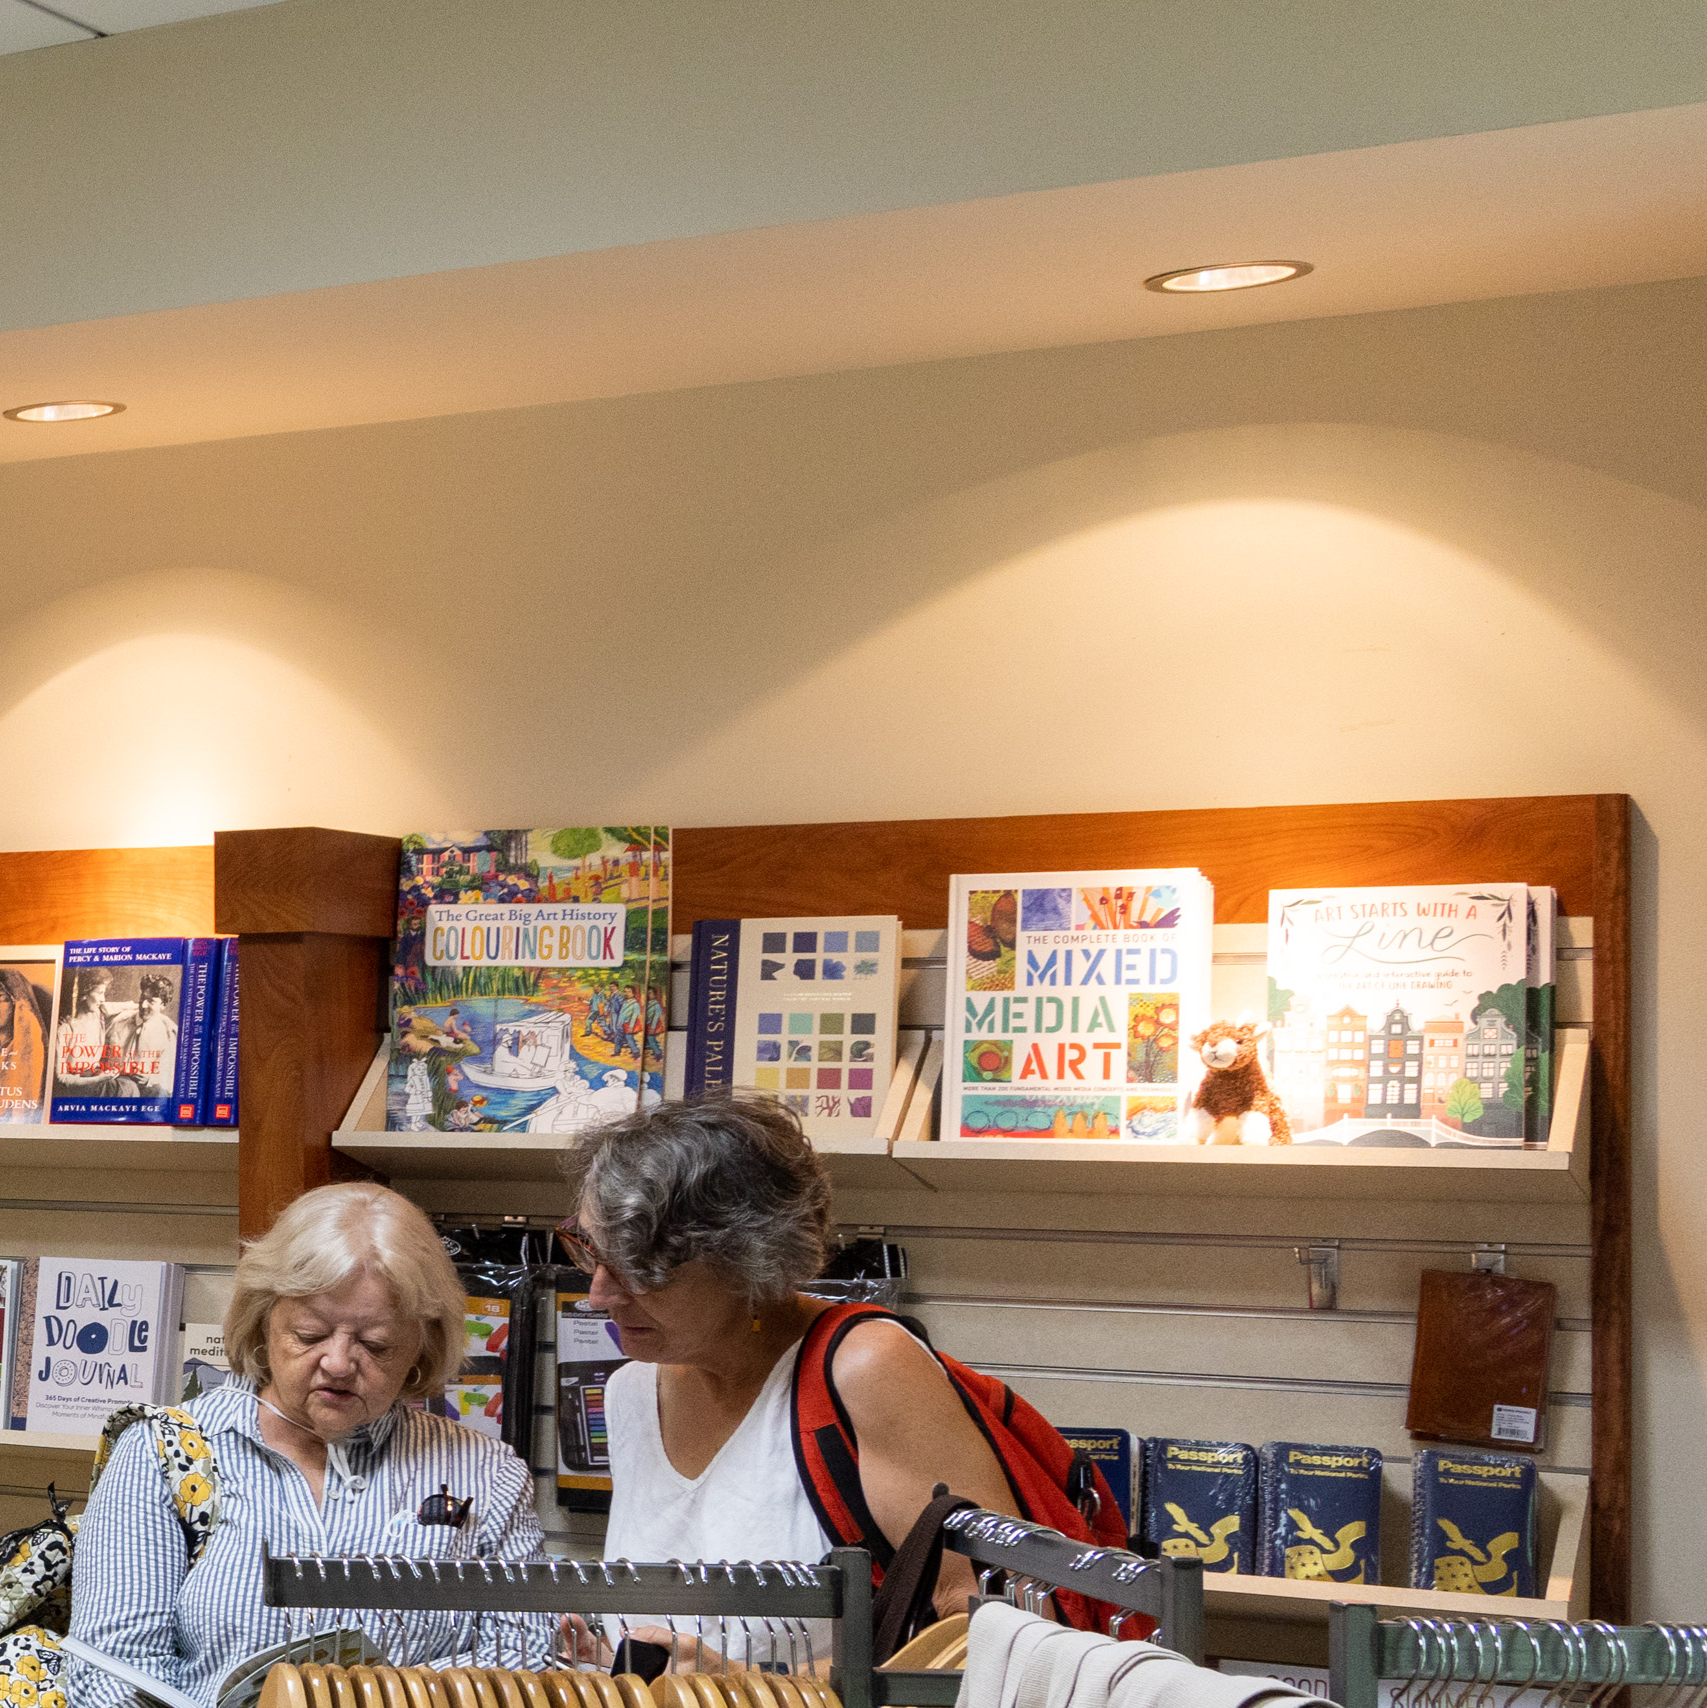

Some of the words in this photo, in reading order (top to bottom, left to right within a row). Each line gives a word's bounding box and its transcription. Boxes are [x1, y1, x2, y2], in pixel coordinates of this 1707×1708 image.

[435, 910, 461, 922] The
[465, 910, 505, 922] Great
[509, 910, 531, 926] Big
[535, 910, 557, 920] Art
[561, 909, 617, 924] History
[1315, 906, 1343, 923] ART
[1351, 902, 1407, 920] STARTS
[1417, 903, 1459, 918] WITH
[1465, 905, 1477, 920] A
[433, 925, 553, 960] COLOURING
[559, 924, 616, 960] BOOK
[1027, 936, 1048, 944] THE
[1054, 934, 1117, 944] COMPLETE
[1123, 934, 1157, 942] BOOK
[1163, 932, 1177, 942] OF
[1321, 921, 1494, 964] Line
[84, 946, 97, 954] LIFE
[98, 946, 119, 954] STORY
[102, 954, 133, 962] MARION
[1027, 948, 1178, 986] MIXED
[707, 934, 729, 1032] NATURE'S
[965, 996, 1116, 1033] MEDIA
[63, 1034, 85, 1042] THE
[61, 1044, 121, 1058] POWER
[141, 1050, 161, 1058] THE
[60, 1061, 160, 1075] IMPOSSIBLE
[705, 1040, 724, 1091] PALE
[1019, 1043, 1121, 1080] ART
[58, 1104, 86, 1112] ARVIA
[91, 1104, 137, 1112] MACKAYE
[141, 1104, 160, 1112] EGE
[485, 1304, 500, 1314] 18
[35, 1402, 60, 1410] Discover
[1167, 1446, 1244, 1464] Passport
[1289, 1451, 1368, 1468] Passport
[1438, 1460, 1522, 1477] Passport
